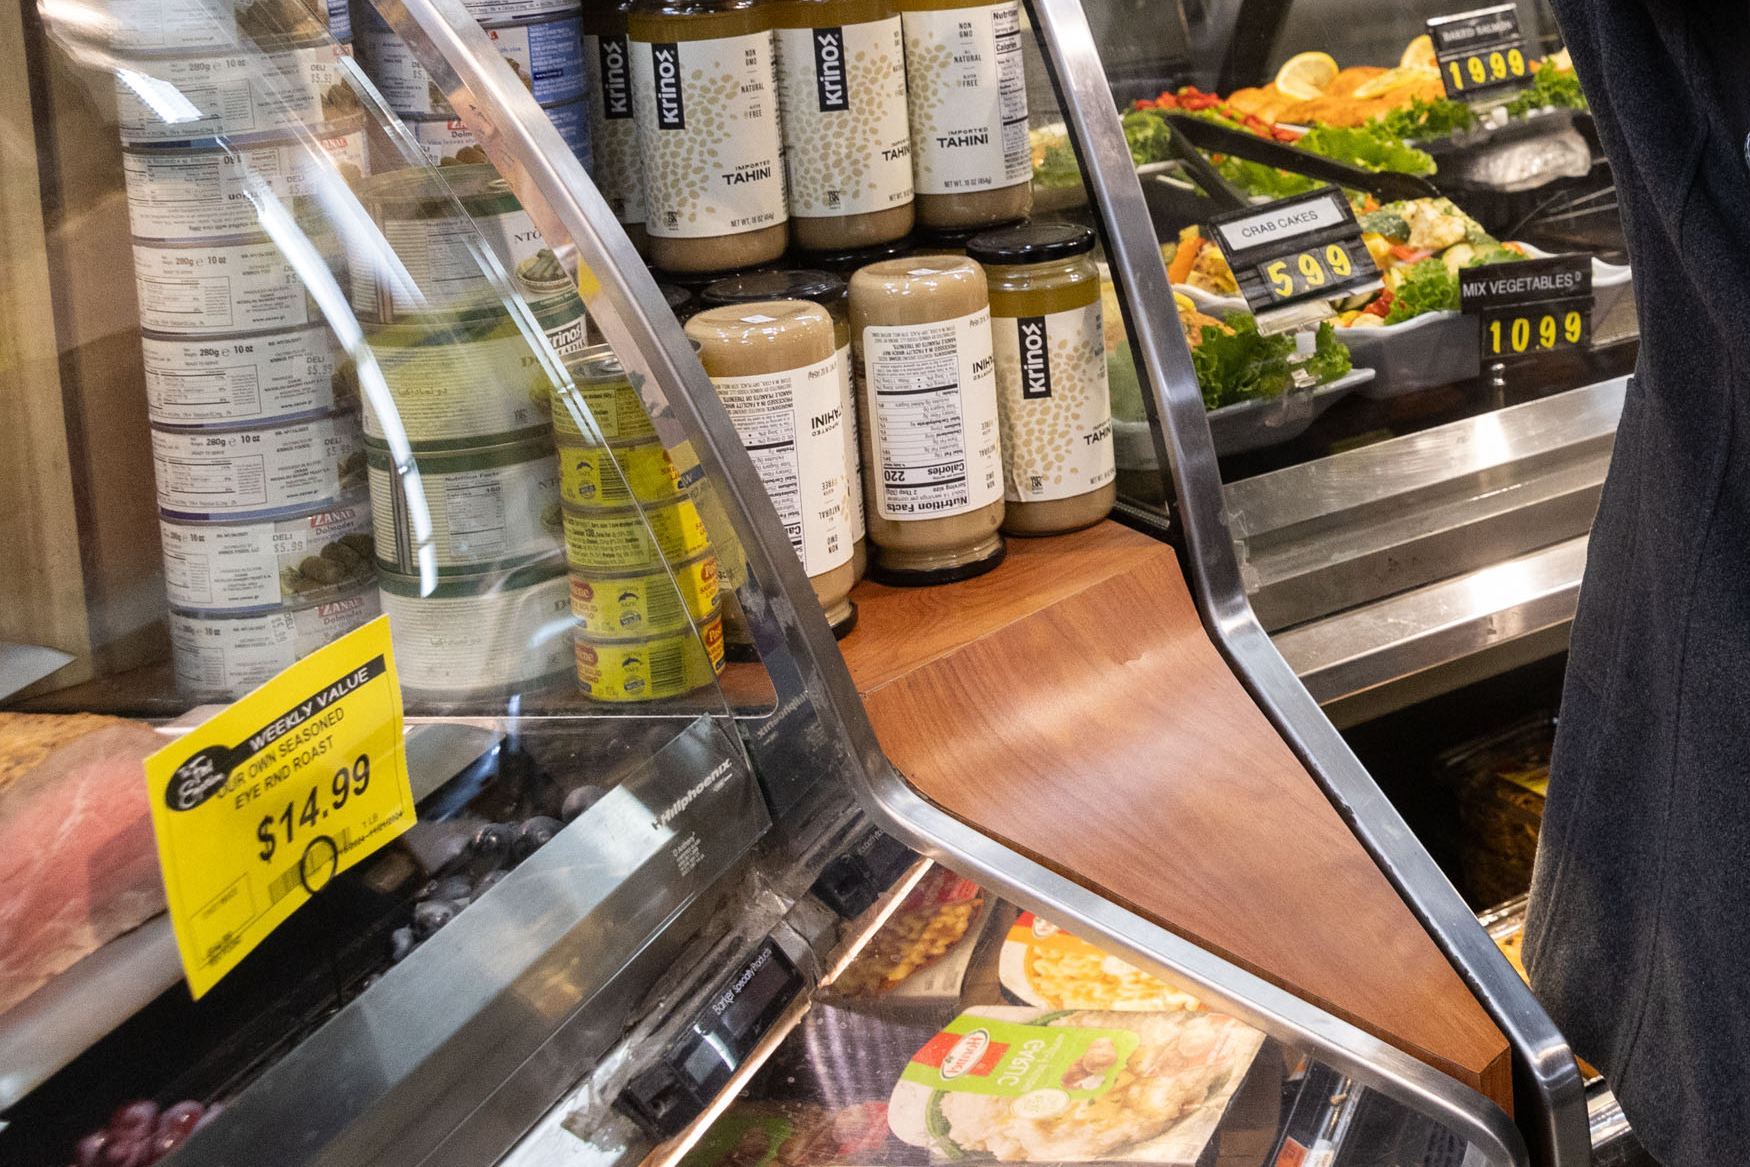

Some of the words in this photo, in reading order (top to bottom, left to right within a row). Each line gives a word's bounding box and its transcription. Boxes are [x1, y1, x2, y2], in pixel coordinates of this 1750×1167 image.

[959, 22, 972, 30] NON
[744, 49, 756, 57] NON
[954, 54, 982, 63] NATURAL
[1449, 48, 1525, 90] 19.99
[741, 83, 764, 94] NATURAL
[963, 79, 978, 88] FREE
[749, 110, 762, 118] FREE
[948, 127, 989, 135] IMPORTED
[936, 133, 989, 149] TAHINI
[722, 168, 771, 185] TAHINI
[1241, 222, 1276, 238] CRAB
[1278, 210, 1318, 228] CAKES
[1267, 244, 1352, 297] 5.99
[1461, 279, 1487, 298] MIX
[1488, 273, 1574, 295] VEGETABLES
[1489, 311, 1581, 354] 10.99
[234, 345, 243, 354] 10
[241, 435, 250, 443] 10
[927, 462, 965, 475] Calories
[884, 470, 905, 481] 220
[887, 504, 914, 512] Facts
[918, 496, 968, 510] Nutrition
[818, 504, 840, 520] NATURAL
[272, 533, 293, 542] DELI
[828, 544, 839, 555] NON
[248, 700, 314, 754] WEEKLY
[315, 666, 370, 711] VALUE
[250, 752, 277, 779] OWN
[279, 706, 345, 757] SEASONED
[235, 783, 262, 810] EYE
[264, 764, 291, 792] RND
[293, 736, 334, 771] ROAST
[257, 753, 370, 864] $14.99
[712, 990, 735, 1015] Barker
